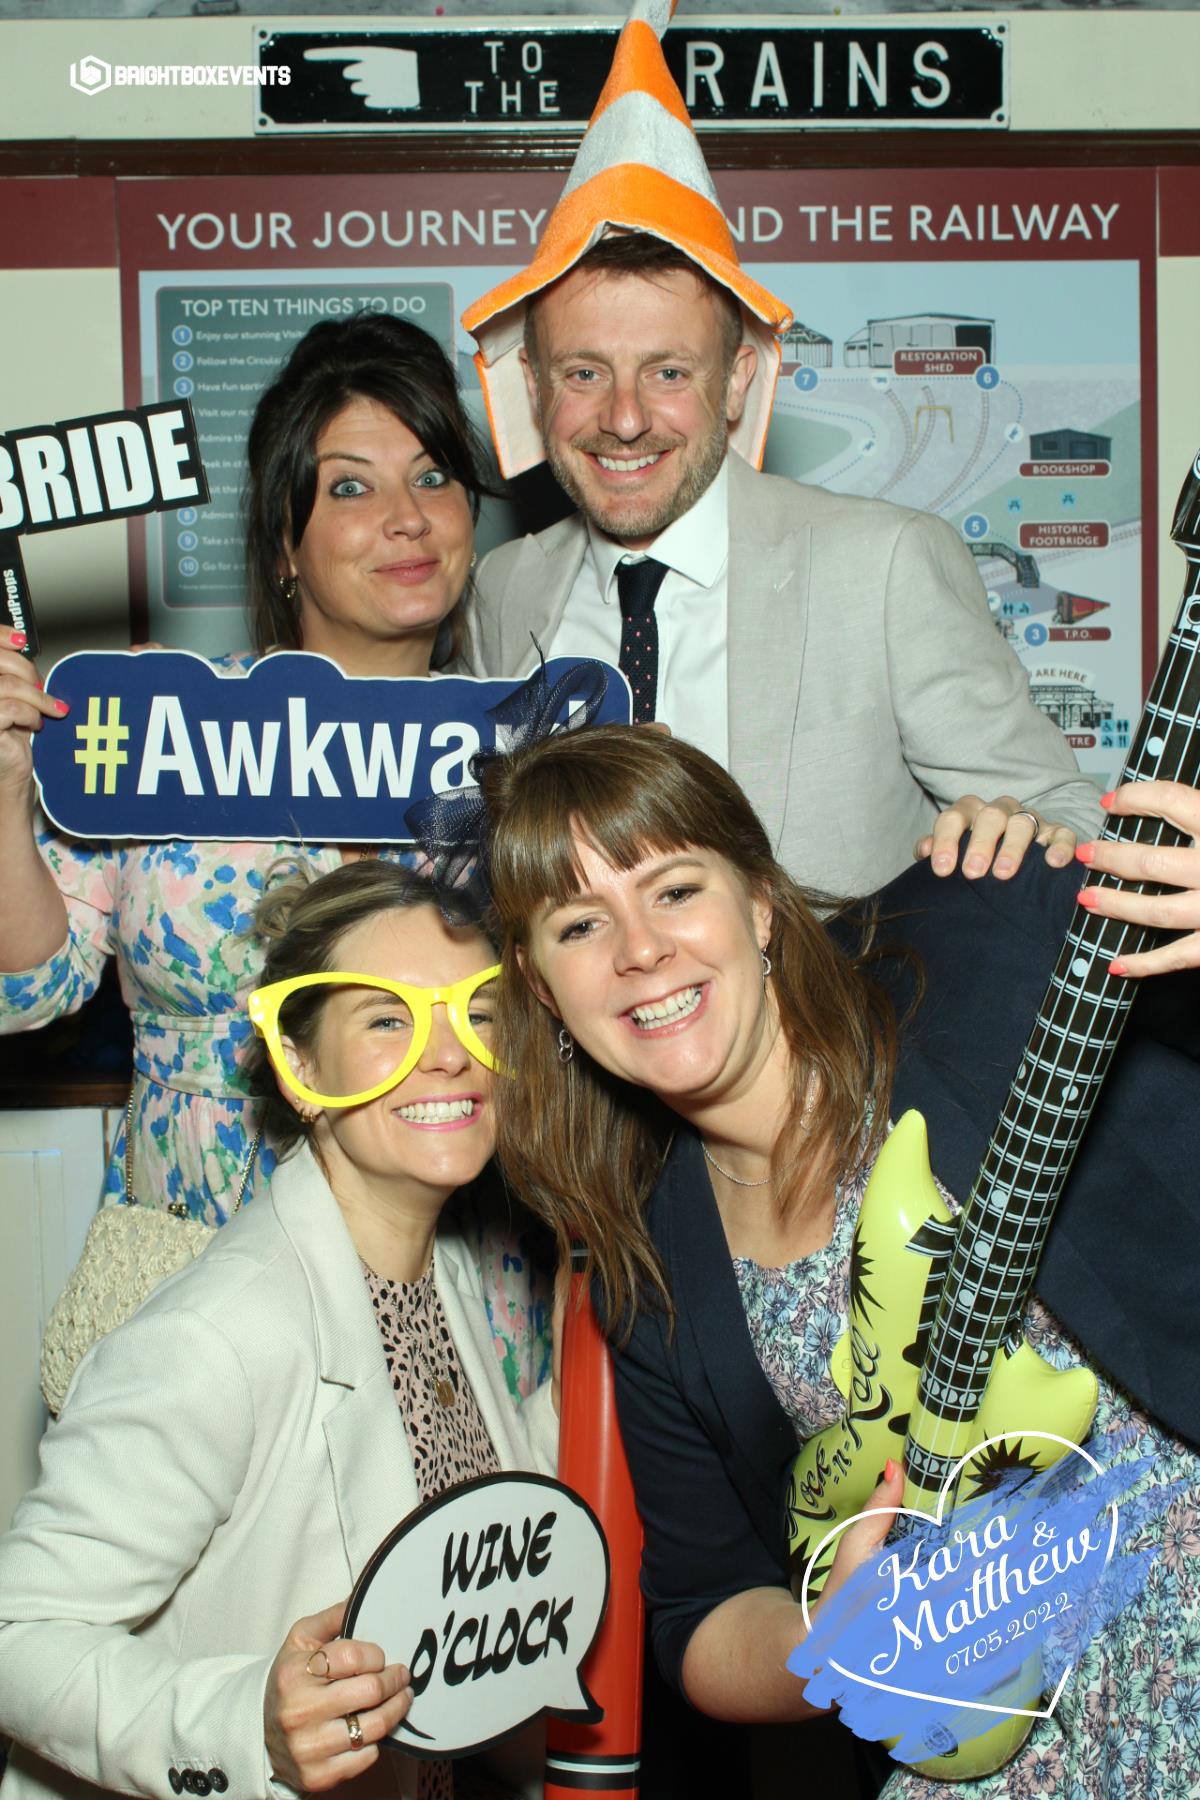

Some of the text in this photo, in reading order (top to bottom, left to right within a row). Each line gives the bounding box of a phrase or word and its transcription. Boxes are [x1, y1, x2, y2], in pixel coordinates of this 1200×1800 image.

[484, 41, 543, 74] TO
[686, 41, 951, 108] RAINS
[464, 80, 561, 114] THE
[157, 212, 297, 250] YOUR
[313, 209, 548, 249] JOURNEY
[799, 205, 893, 242] THE
[910, 203, 1120, 242] RAILWAY
[181, 296, 426, 317] TOP TEN THINGS TO DO
[196, 331, 221, 342] Enjoy
[241, 331, 281, 342] stunning
[196, 357, 227, 366] Follow
[229, 356, 245, 365] the
[900, 351, 978, 363] RESTORATION
[924, 363, 955, 374] SHED
[0, 410, 199, 530] BRIDE
[1032, 463, 1096, 475] BOOKSHOP
[1038, 524, 1091, 535] HISTORIC
[1029, 535, 1099, 546] FOOTBRIDGE
[1064, 629, 1093, 640] T.P.O.
[1035, 667, 1088, 684] ARE HERE
[442, 1511, 557, 1599] WINE
[409, 1596, 574, 1698] O'CLOCK
